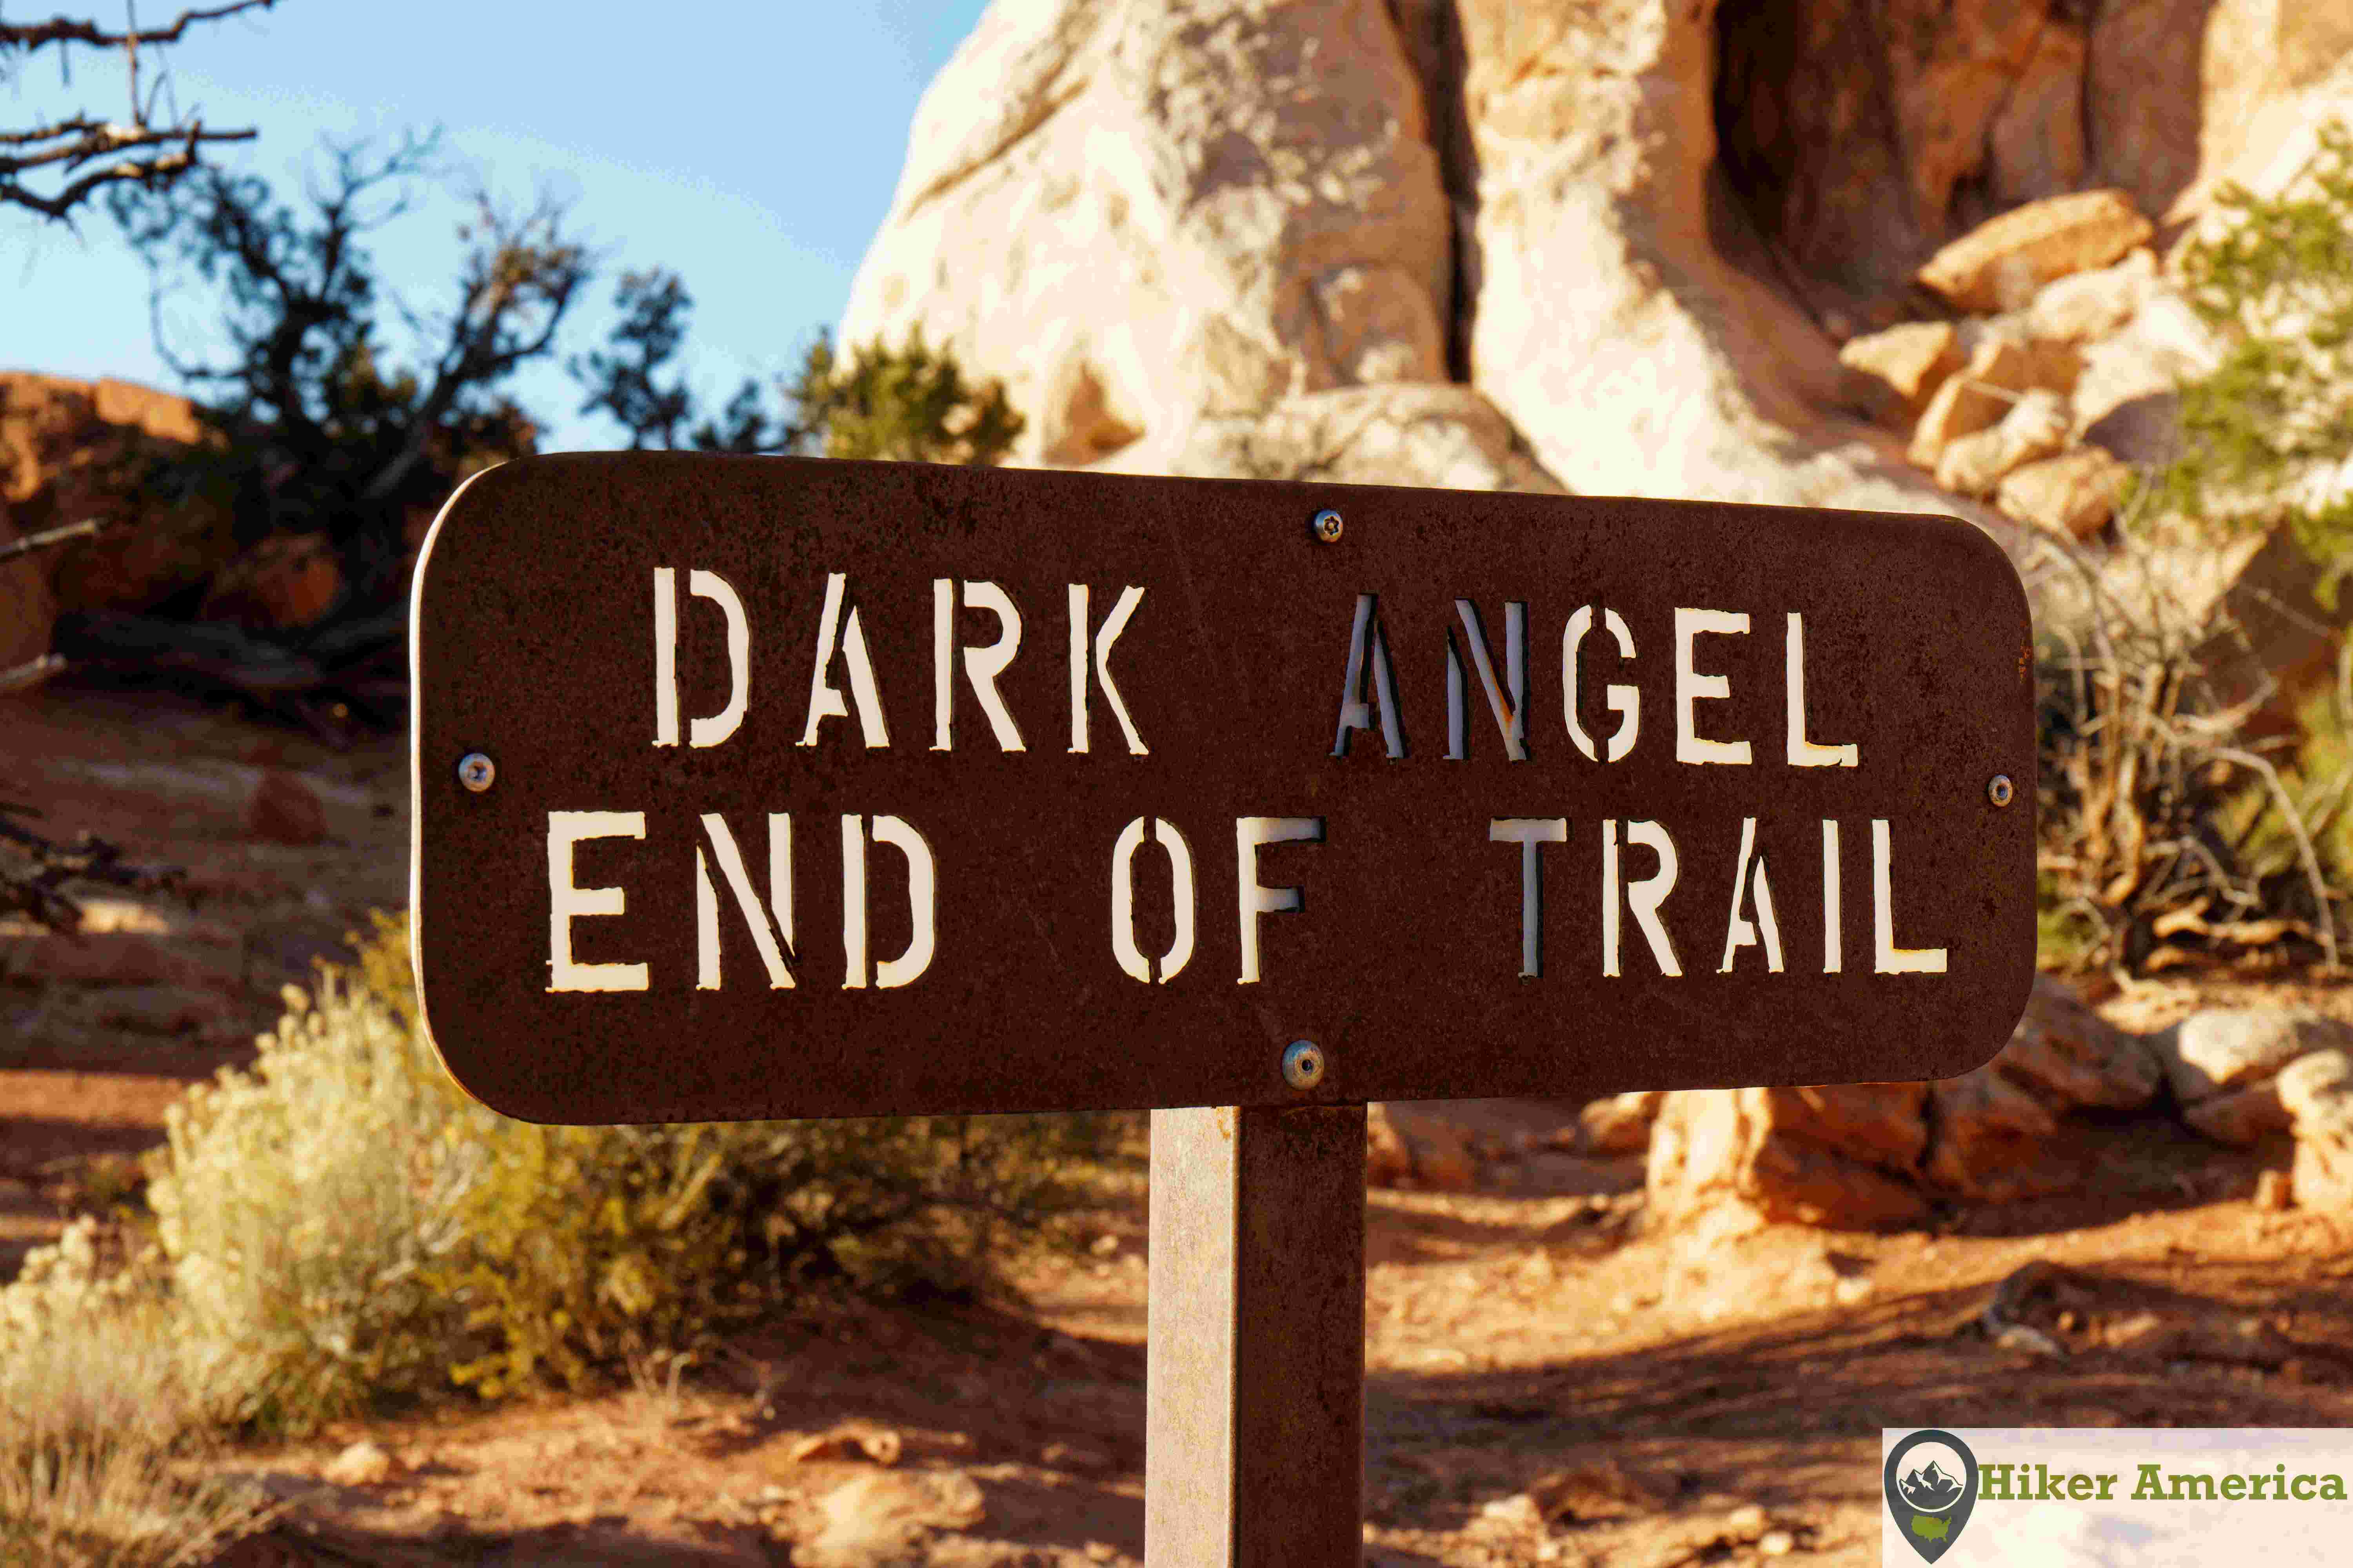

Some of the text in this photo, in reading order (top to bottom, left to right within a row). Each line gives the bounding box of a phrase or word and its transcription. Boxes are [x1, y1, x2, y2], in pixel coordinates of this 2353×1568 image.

[651, 567, 1859, 767] DARK ANGEL
[546, 811, 1948, 991] END OF TRAIL
